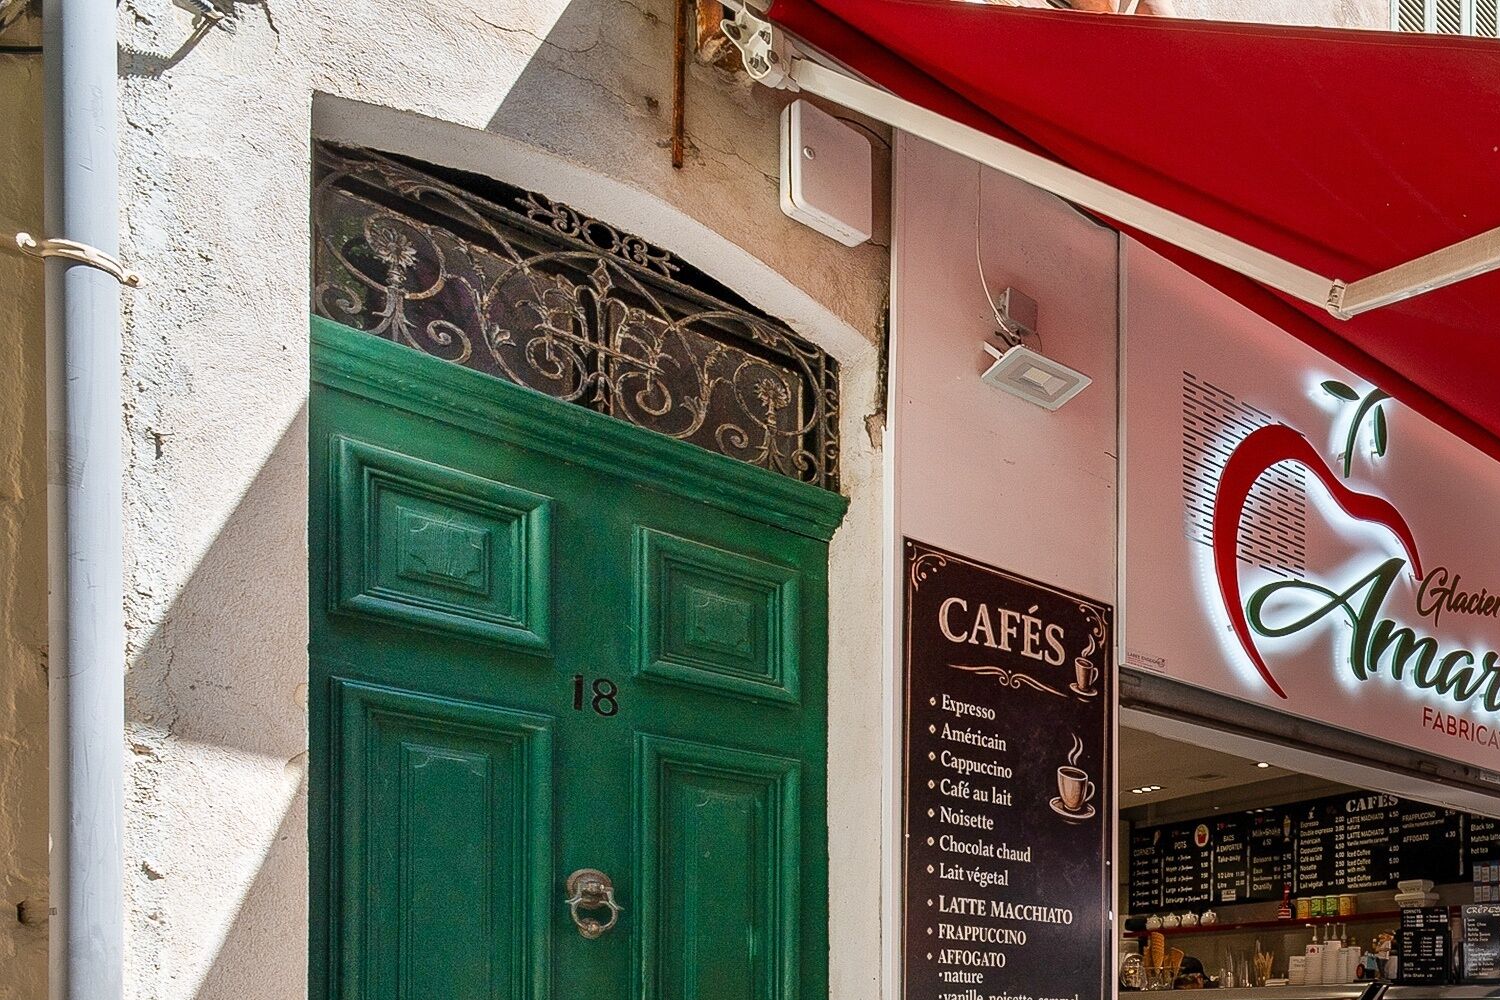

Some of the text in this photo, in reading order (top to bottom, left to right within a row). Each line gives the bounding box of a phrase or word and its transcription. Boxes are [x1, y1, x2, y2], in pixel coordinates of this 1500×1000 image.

[938, 597, 1066, 666] CAFÉS
[573, 674, 619, 716] 18
[942, 694, 996, 721] Expresso
[941, 722, 1007, 752] Américain
[941, 750, 1012, 779] Cappuccino
[940, 778, 1012, 807] Café au lait
[940, 806, 994, 830] Noisette
[940, 835, 1031, 862] Chocolat chaud
[940, 863, 1010, 888] Lait végetal
[939, 895, 1073, 925] LATTE MACCHIATO
[938, 924, 1027, 945] FRAPPUCCINO
[938, 949, 1006, 968] AFFOGATO
[944, 969, 983, 984] nature
